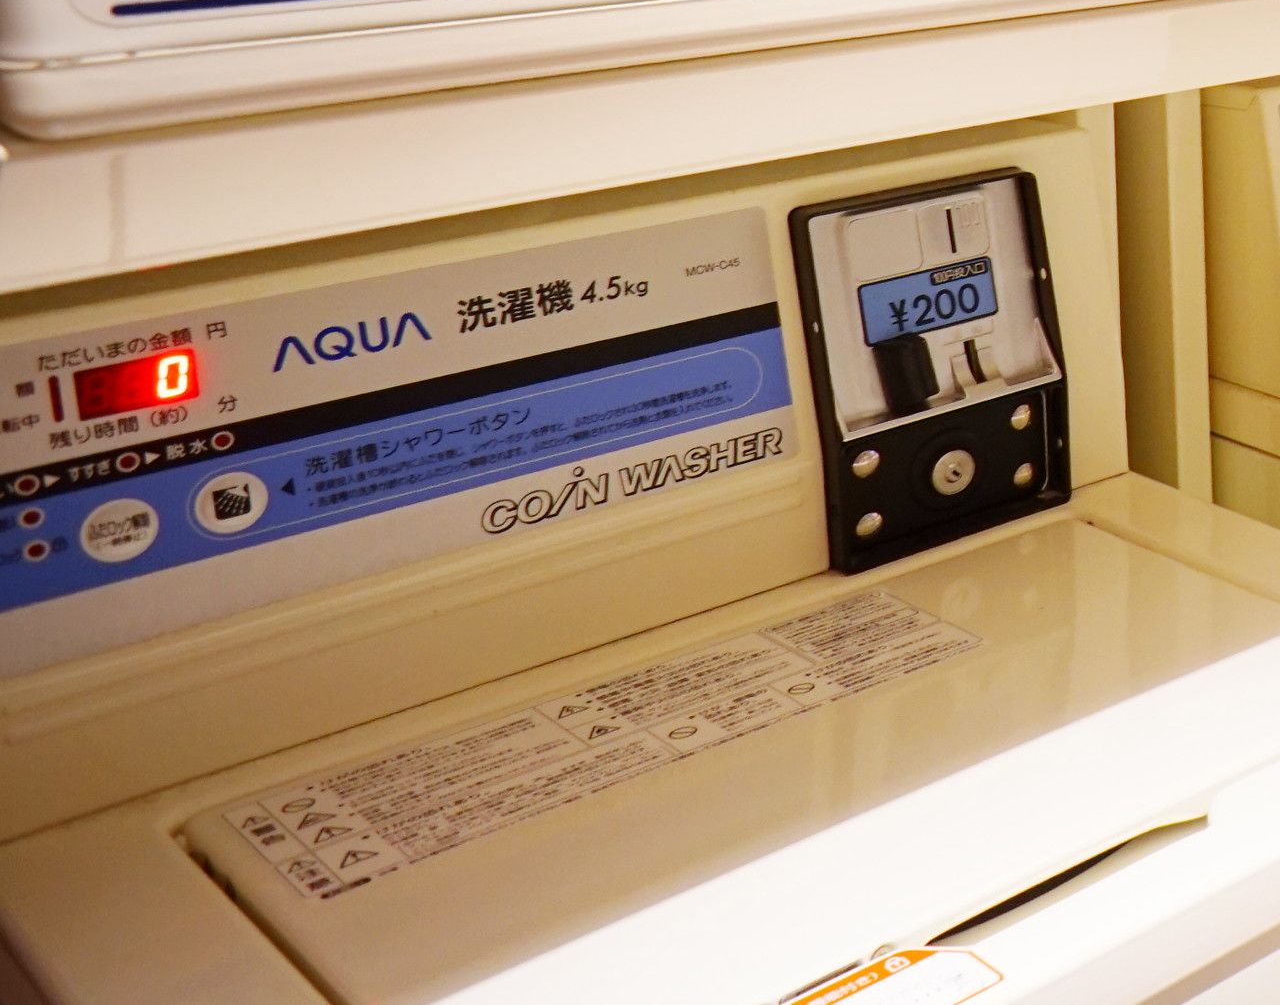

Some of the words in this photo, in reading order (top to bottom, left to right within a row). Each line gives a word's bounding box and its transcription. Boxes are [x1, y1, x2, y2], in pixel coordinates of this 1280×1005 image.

[455, 278, 575, 334] 洗濯機
[579, 275, 650, 305] 4.5kg
[889, 282, 981, 332] ¥200
[38, 327, 193, 373] ただいまの金額
[205, 320, 228, 340] 円
[272, 311, 433, 374] AQUA
[156, 354, 190, 400] 0
[217, 394, 238, 413] 分
[66, 462, 111, 484] すすぎ
[166, 438, 208, 463] 脱水
[303, 407, 532, 478] 洗濯槽シャワーボタン
[618, 426, 784, 496] WASHER
